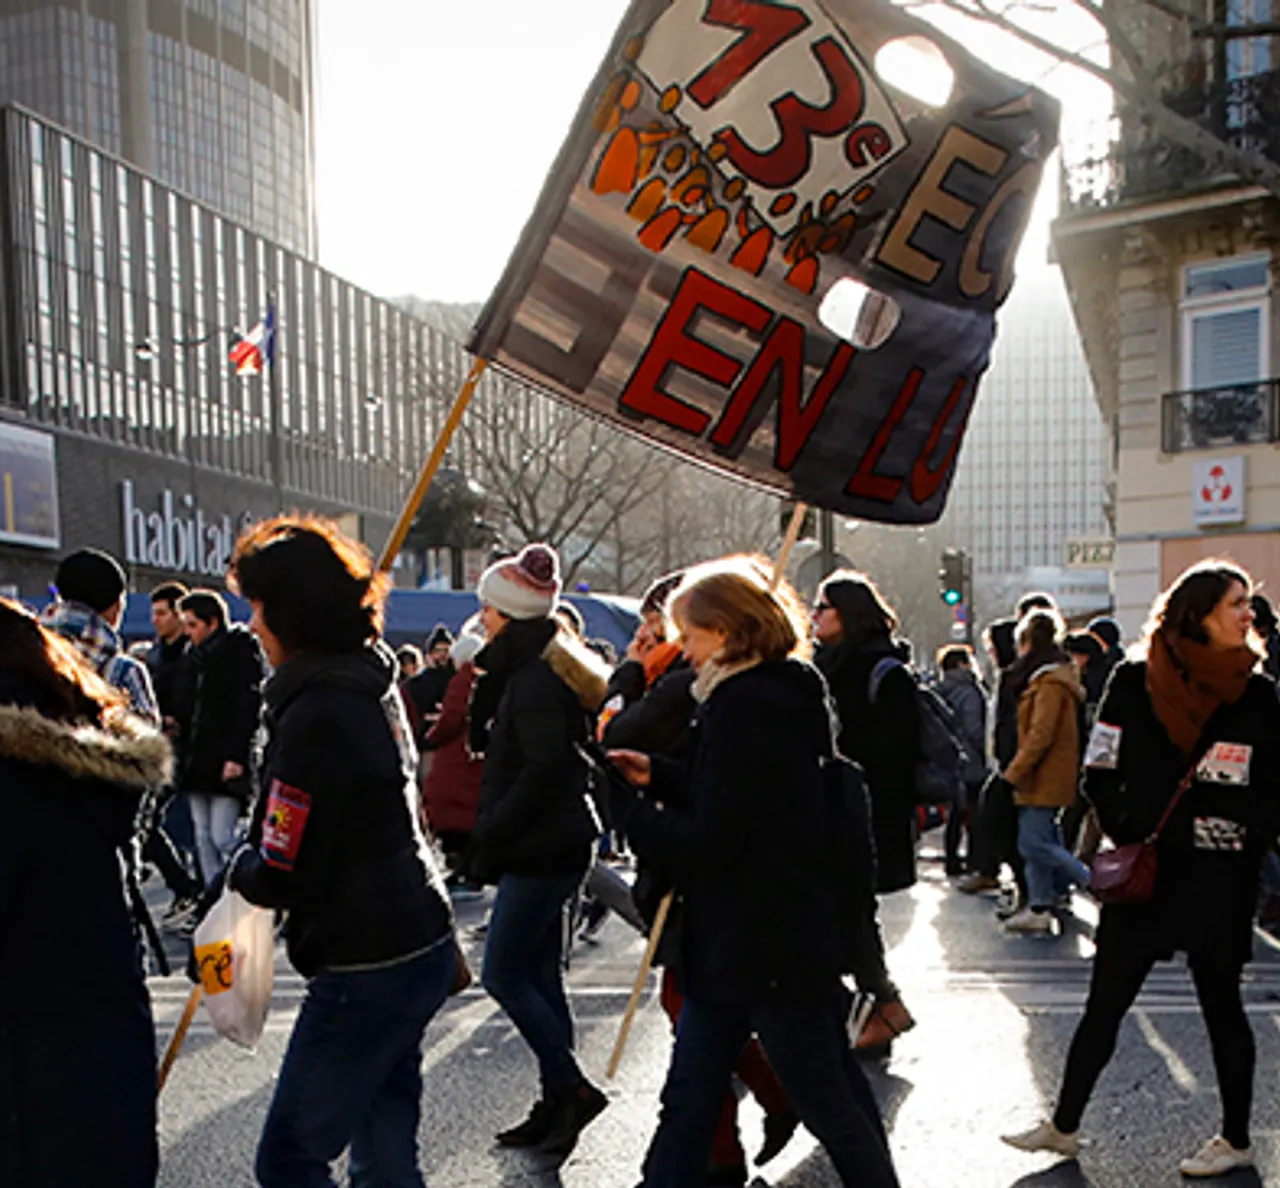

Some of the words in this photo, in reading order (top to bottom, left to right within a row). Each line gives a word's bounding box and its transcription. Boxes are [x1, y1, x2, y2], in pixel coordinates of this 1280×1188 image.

[873, 91, 1044, 302] ÉC
[620, 266, 857, 472] EN
[123, 479, 232, 577] habitat
